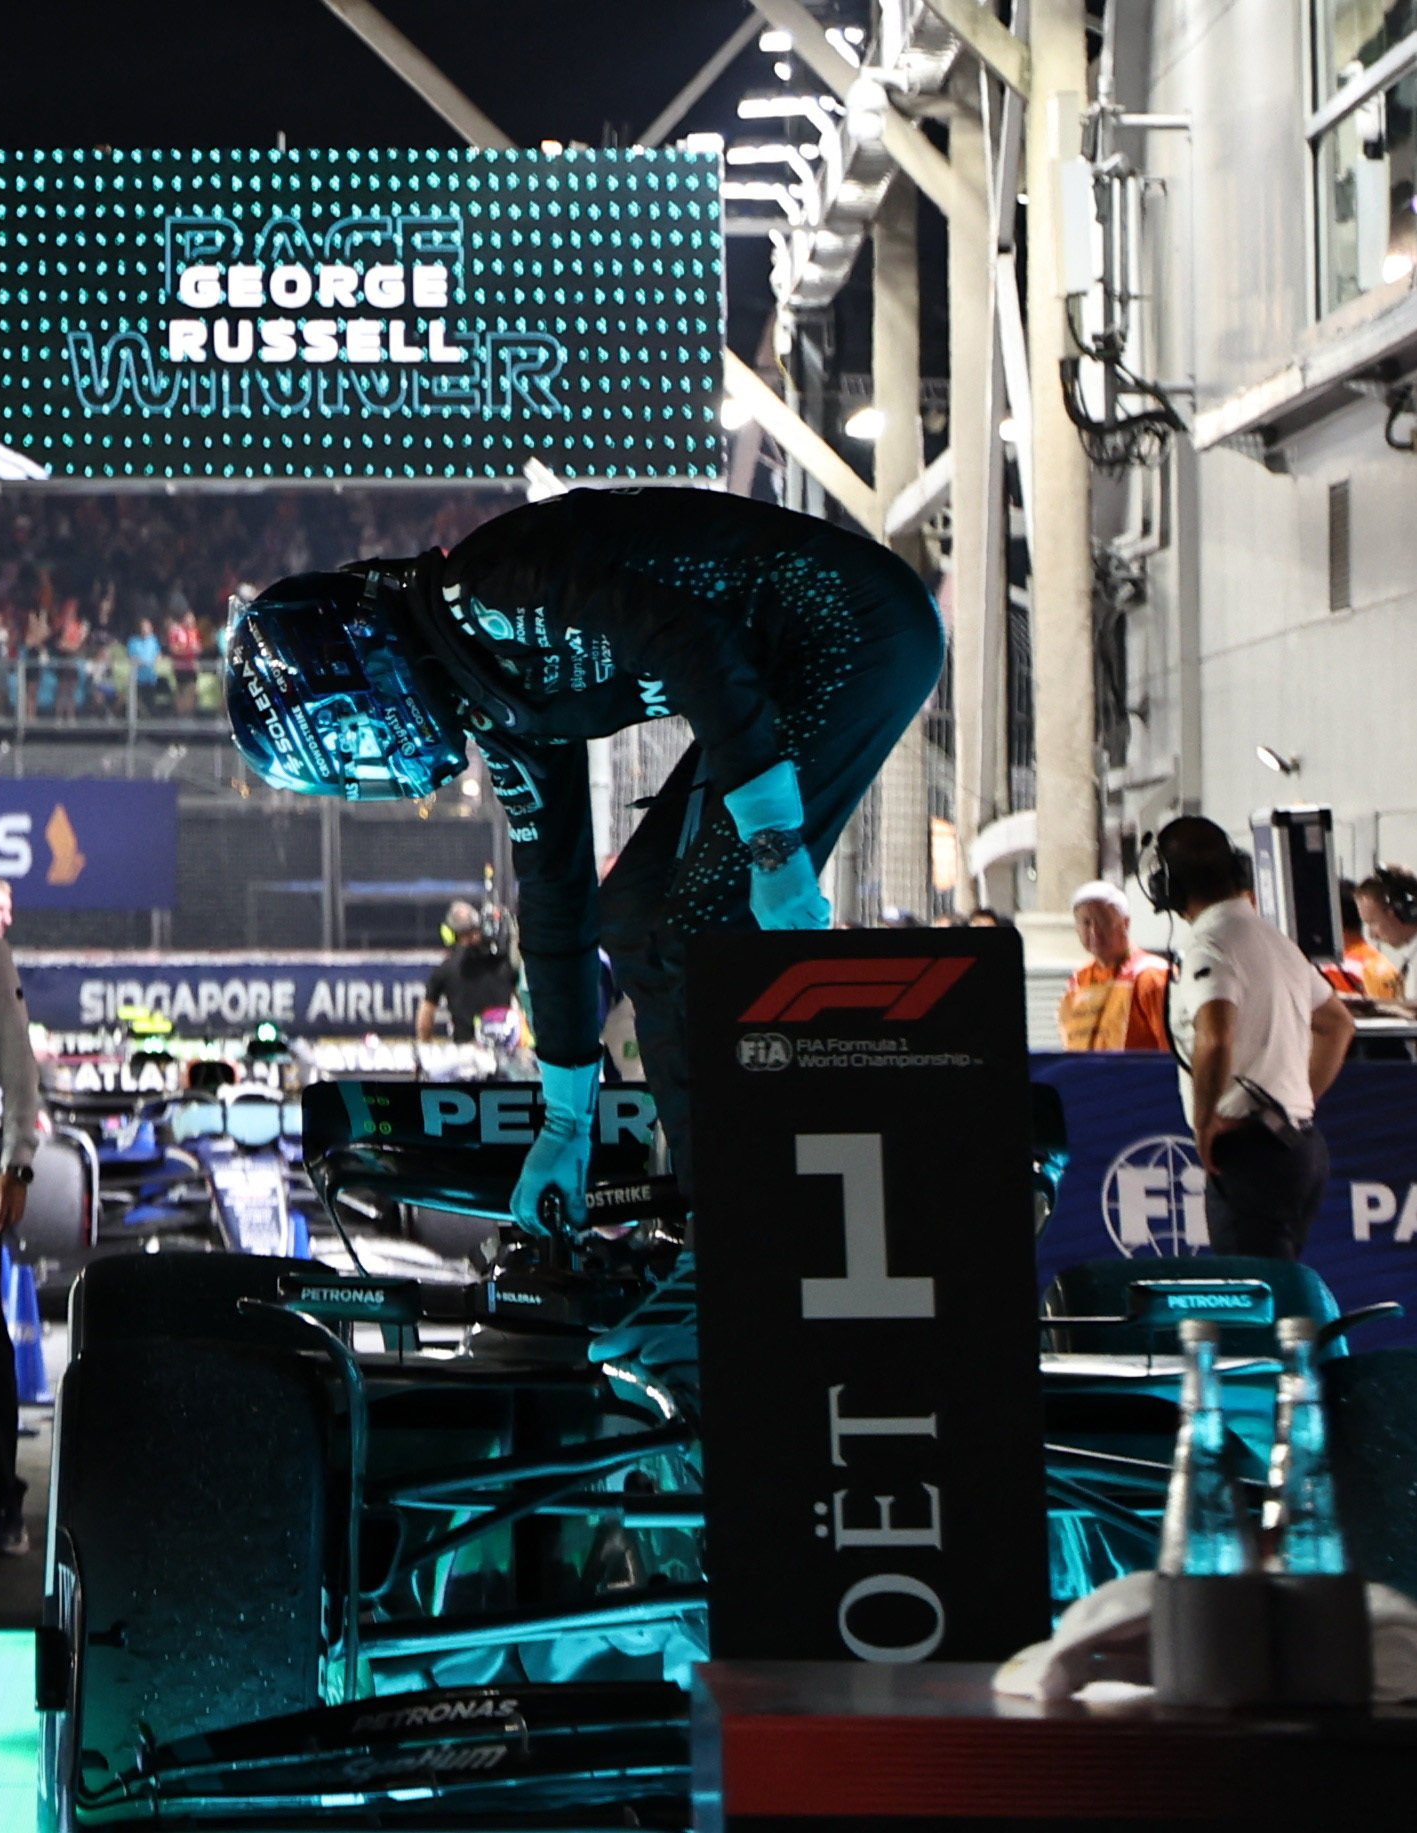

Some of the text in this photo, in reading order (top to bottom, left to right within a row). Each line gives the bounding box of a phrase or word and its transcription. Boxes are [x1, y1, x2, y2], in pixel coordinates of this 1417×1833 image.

[179, 265, 449, 309] GEORGE
[168, 320, 464, 363] RUSSELL
[242, 660, 295, 756] SOLERA
[291, 705, 331, 779] CROWDSTRIKE
[79, 979, 450, 1025] SINGAPORE AIRLIN
[737, 956, 978, 1022] F1
[797, 1053, 970, 1069] World Championship
[827, 1038, 897, 1051] Formula
[900, 1037, 909, 1051] 1
[794, 1132, 936, 1319] 1
[300, 1286, 385, 1304] PETRONAS
[1167, 1294, 1253, 1309] PETRONAS
[351, 1698, 520, 1734] PETRONAS
